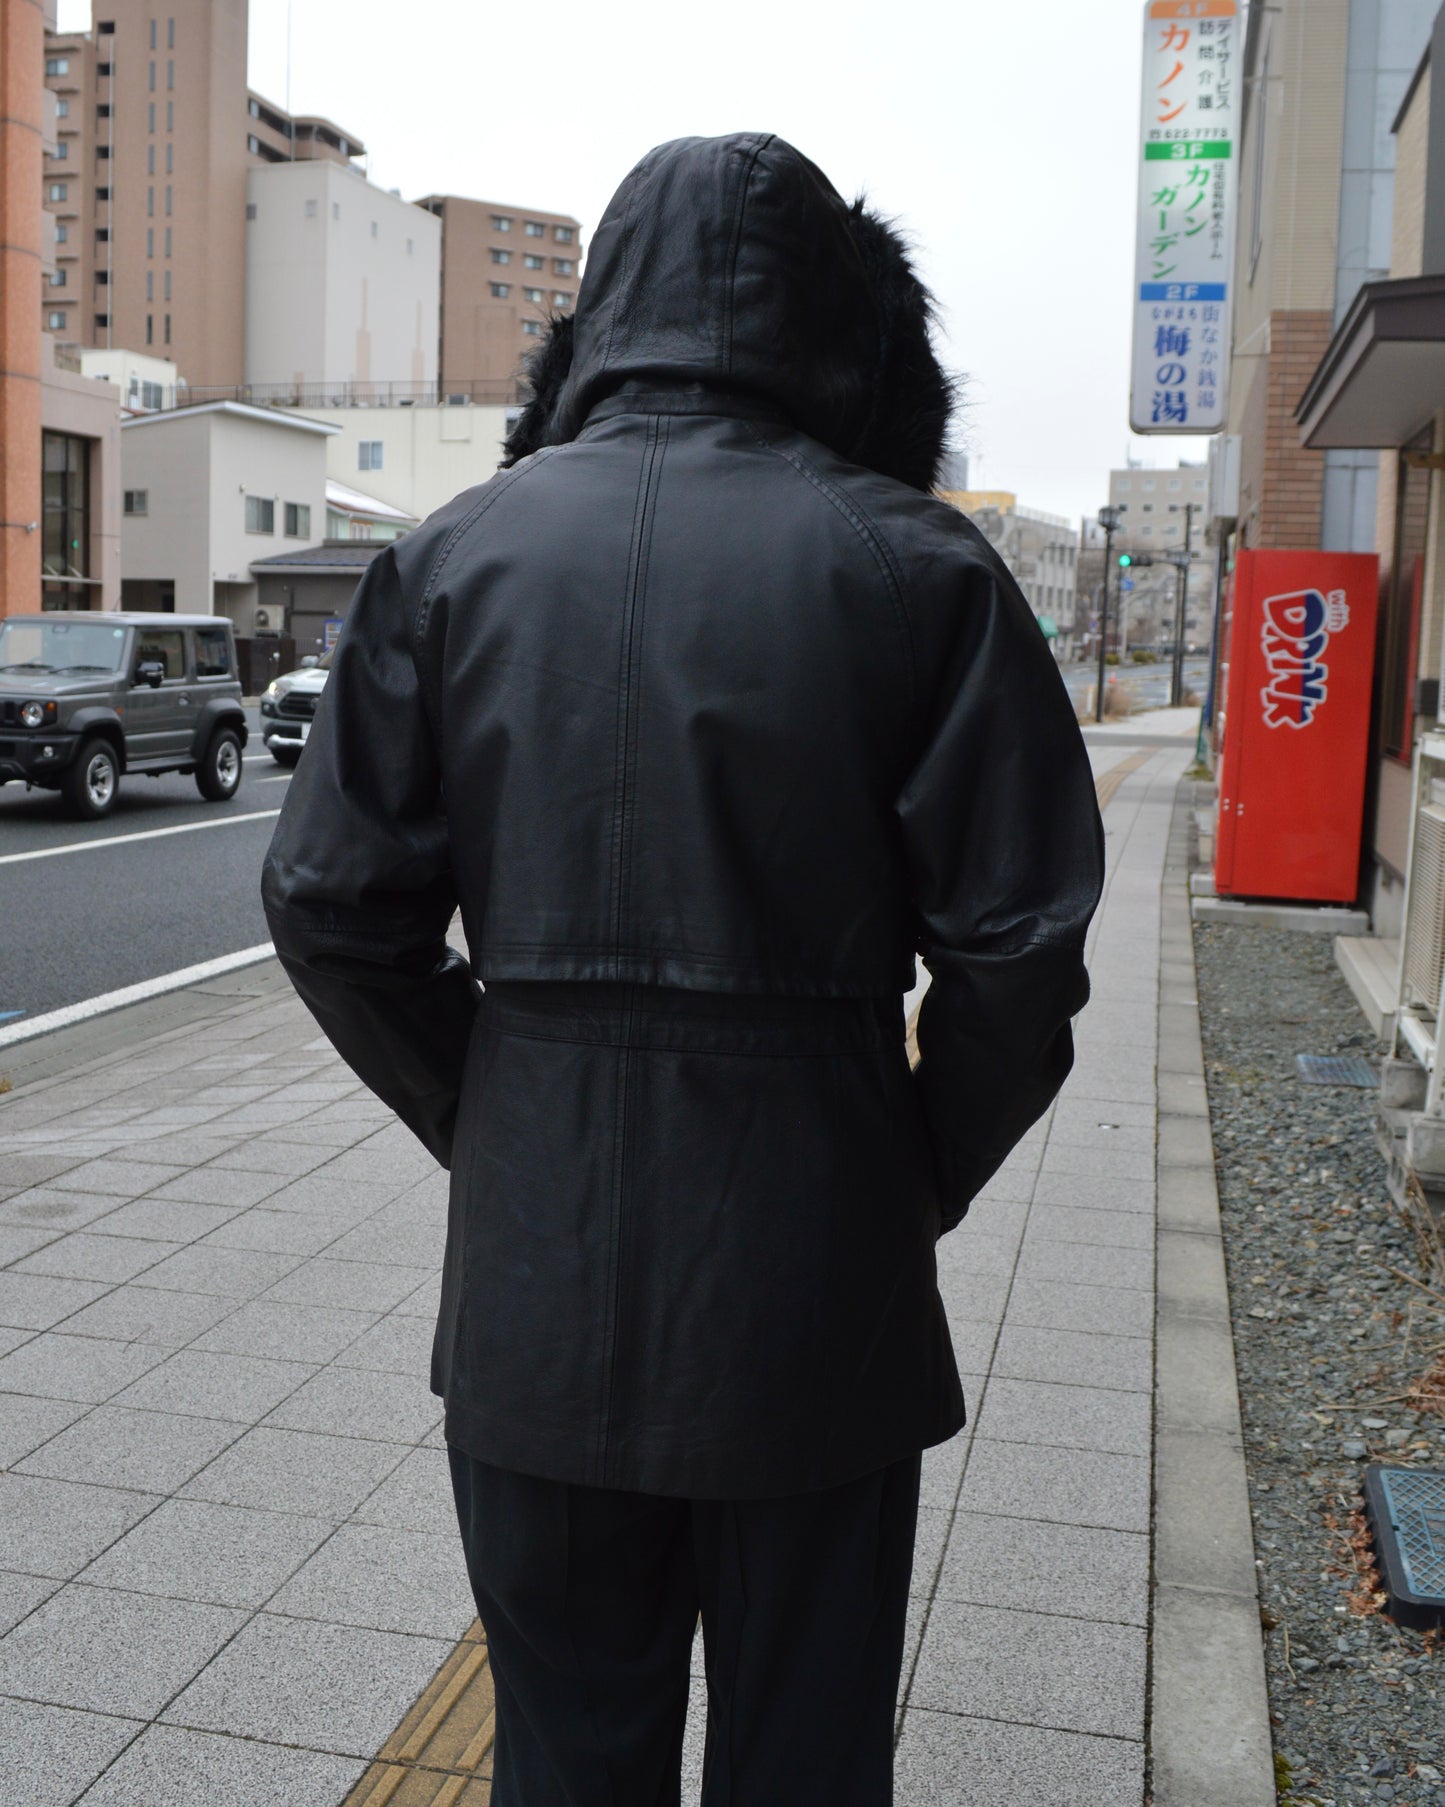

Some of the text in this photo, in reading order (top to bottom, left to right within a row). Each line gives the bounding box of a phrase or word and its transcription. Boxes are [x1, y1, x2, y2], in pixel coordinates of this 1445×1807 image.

[1176, 2, 1208, 16] 4F
[1157, 22, 1191, 124] カノン
[1216, 20, 1231, 110] デイサービス
[1171, 143, 1204, 159] 3F
[1150, 183, 1181, 280] ガーデン
[1184, 163, 1211, 237] カノン
[1166, 284, 1199, 299] 2F
[1152, 323, 1192, 424] 梅の湯
[1261, 588, 1329, 729] DRINK
